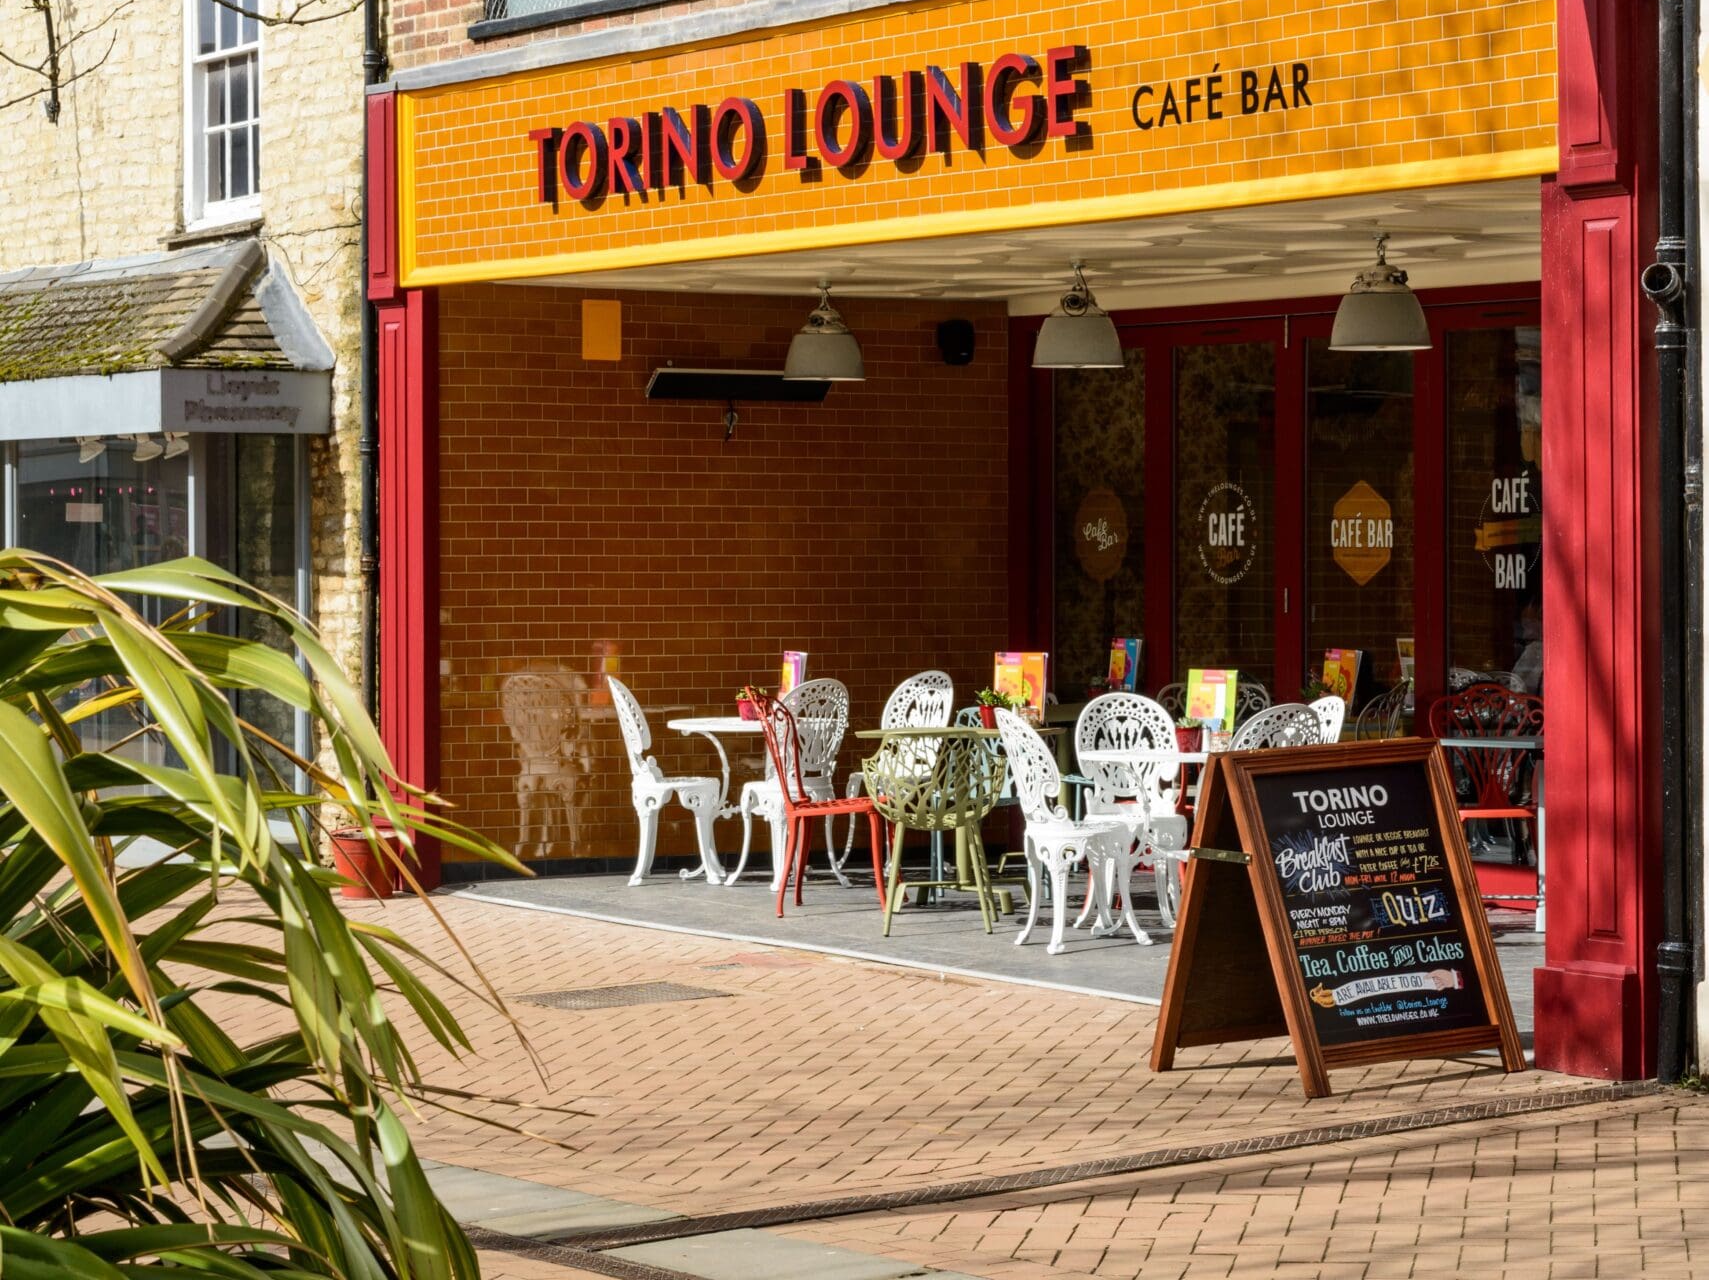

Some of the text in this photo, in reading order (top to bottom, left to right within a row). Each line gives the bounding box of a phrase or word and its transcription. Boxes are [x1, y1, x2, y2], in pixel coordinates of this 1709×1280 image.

[528, 45, 1313, 205] TORINO LOUNGE CAFÉ BAR
[1491, 470, 1530, 514] CAFÉ
[1208, 504, 1245, 547] CAFÉ
[1330, 512, 1394, 548] CAFÉ BAR
[1495, 554, 1526, 590] BAR
[1292, 784, 1389, 814] TORINO
[1318, 810, 1376, 829] LOUNGE
[1275, 833, 1351, 879] Breakfast
[1299, 869, 1342, 894] Club
[1289, 904, 1351, 921] EVERY MONDAY
[1296, 917, 1320, 930] NIGHT
[1328, 915, 1348, 927] 8PM
[1303, 928, 1318, 937] PER
[1318, 926, 1349, 936] PERSON
[1299, 935, 1465, 978] Tea, Coffee AND Cakes
[1336, 974, 1424, 1003] ARE AVAILABLE TO GO
